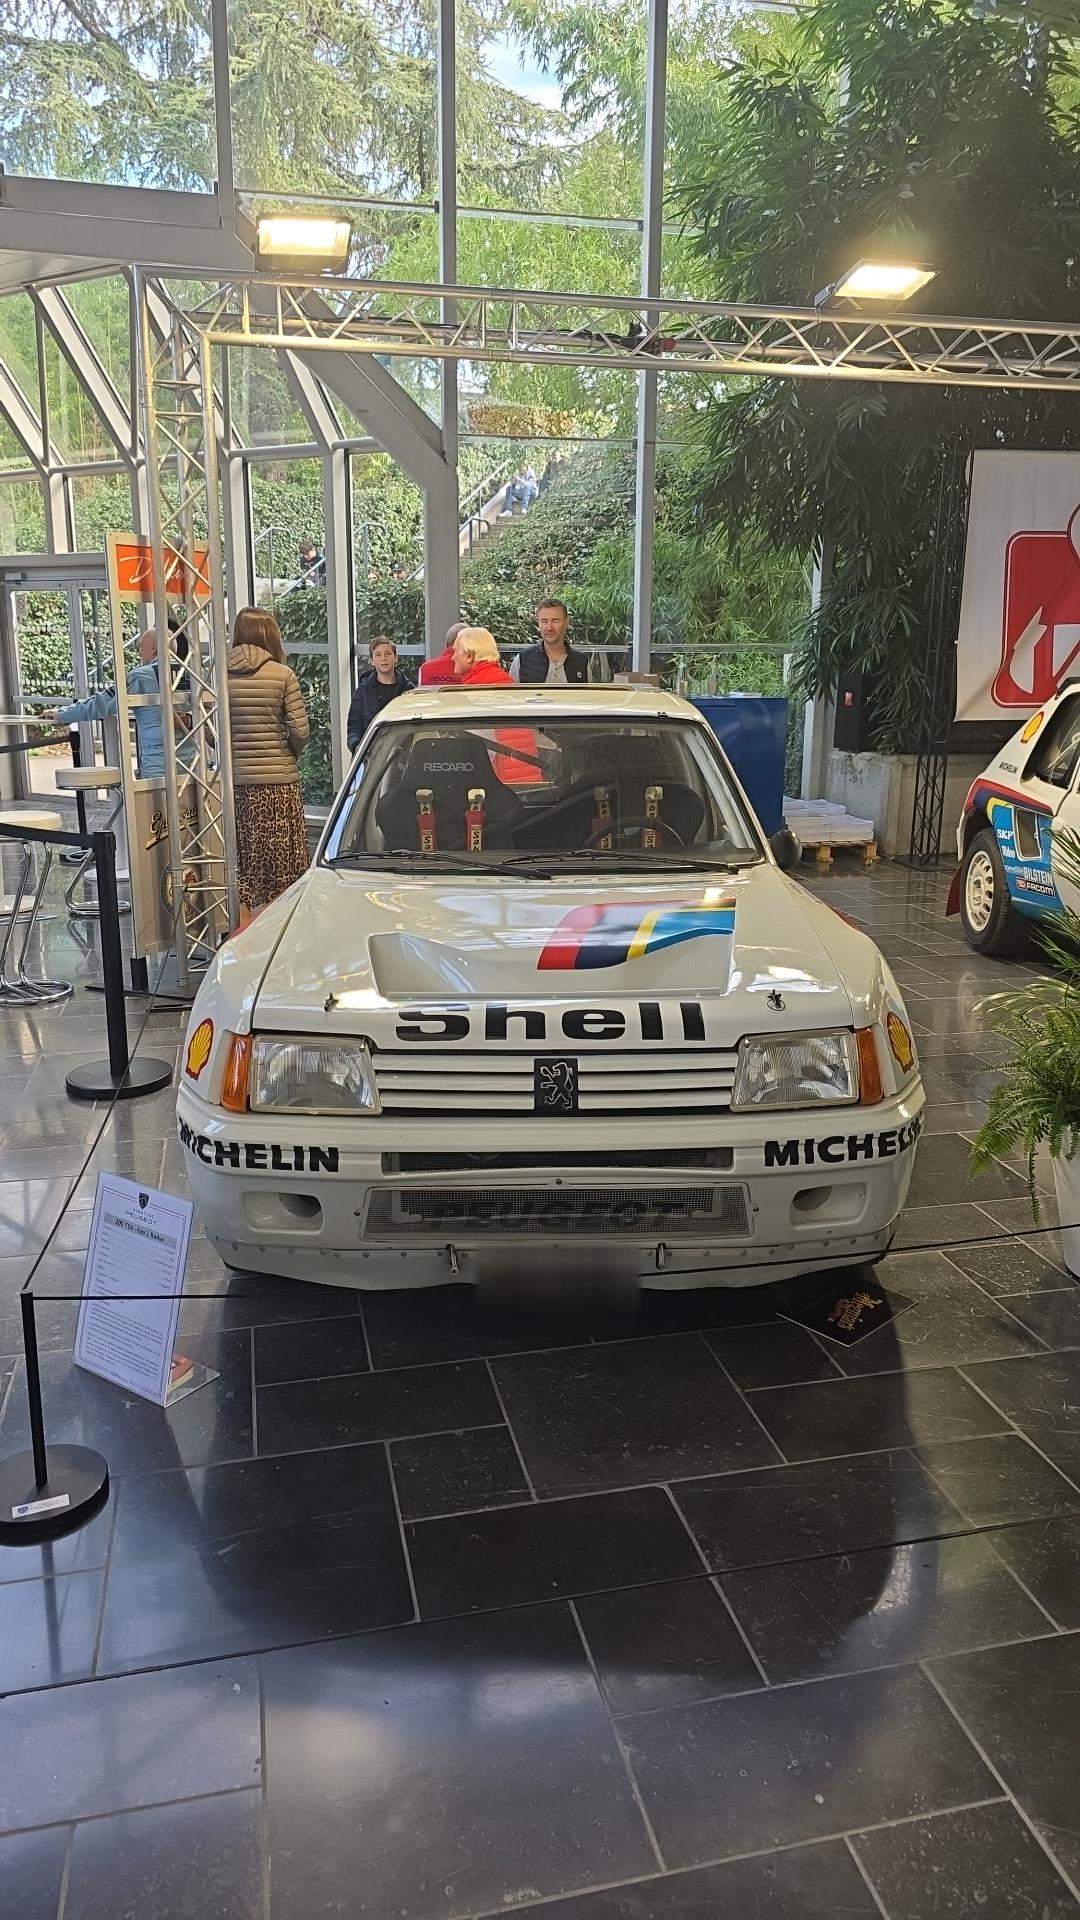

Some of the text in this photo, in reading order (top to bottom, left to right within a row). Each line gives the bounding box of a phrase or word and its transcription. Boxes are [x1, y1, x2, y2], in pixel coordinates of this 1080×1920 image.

[423, 762, 474, 772] RECARO
[1027, 882, 1054, 896] FACOM
[395, 1002, 706, 1042] Shell
[178, 1116, 339, 1173] MICHELIN
[115, 1219, 124, 1227] 205
[124, 1210, 158, 1226] PEUGEOT
[428, 1200, 684, 1230] PEUGEOT
